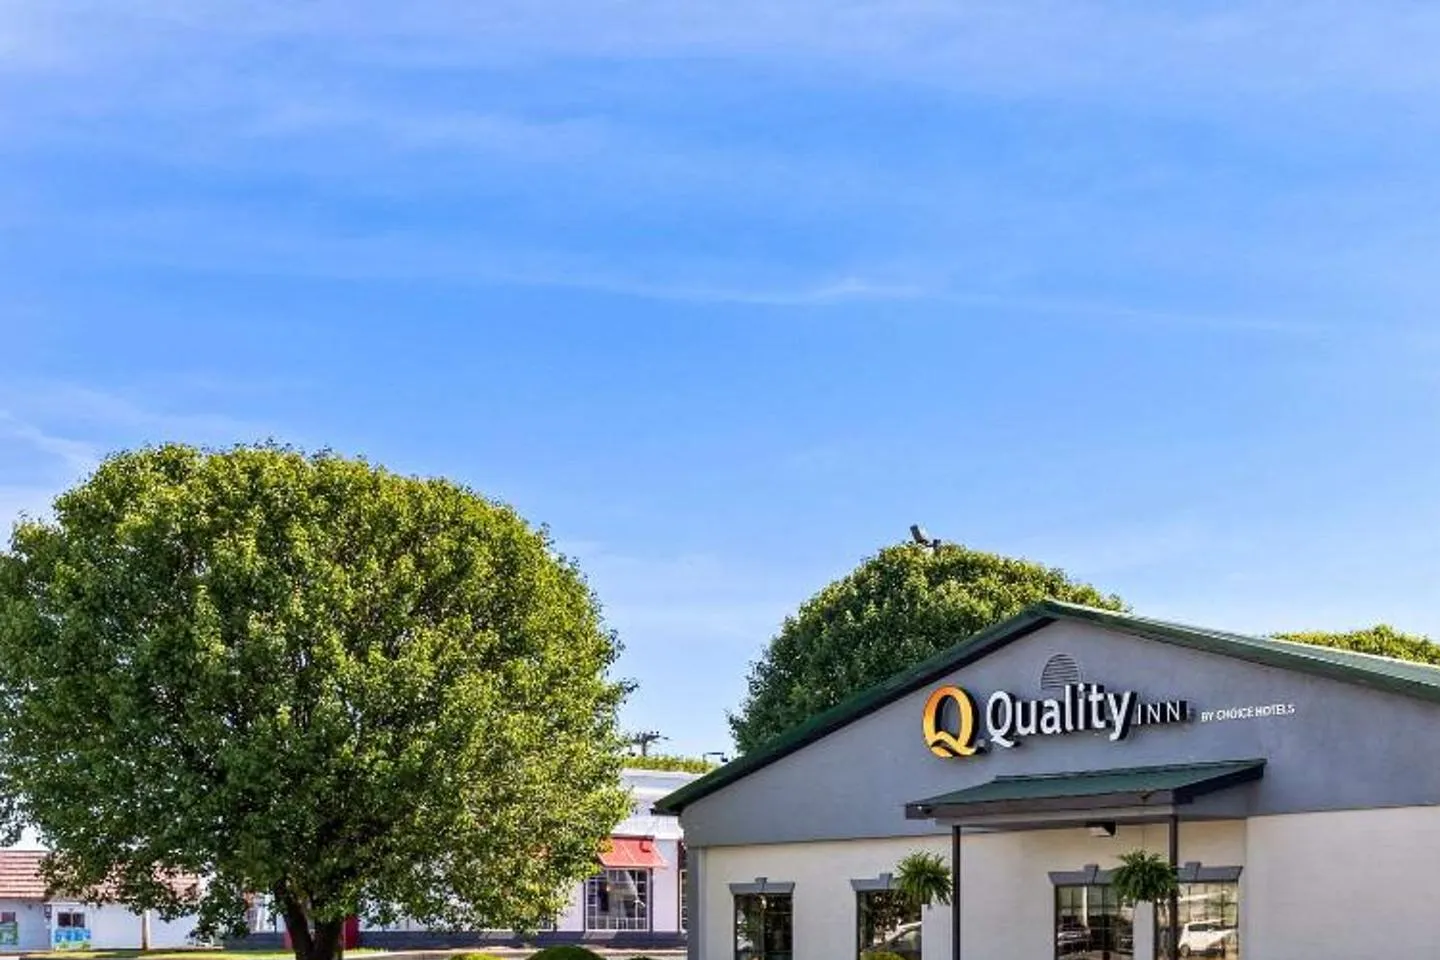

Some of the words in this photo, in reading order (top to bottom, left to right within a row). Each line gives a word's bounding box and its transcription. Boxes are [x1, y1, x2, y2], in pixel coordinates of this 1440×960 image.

[922, 685, 976, 758] Q
[986, 683, 1131, 747] Quality
[1138, 700, 1180, 724] INN
[1201, 711, 1214, 722] BY
[1216, 707, 1254, 721] CHOICE
[1255, 704, 1295, 718] HOTELS
